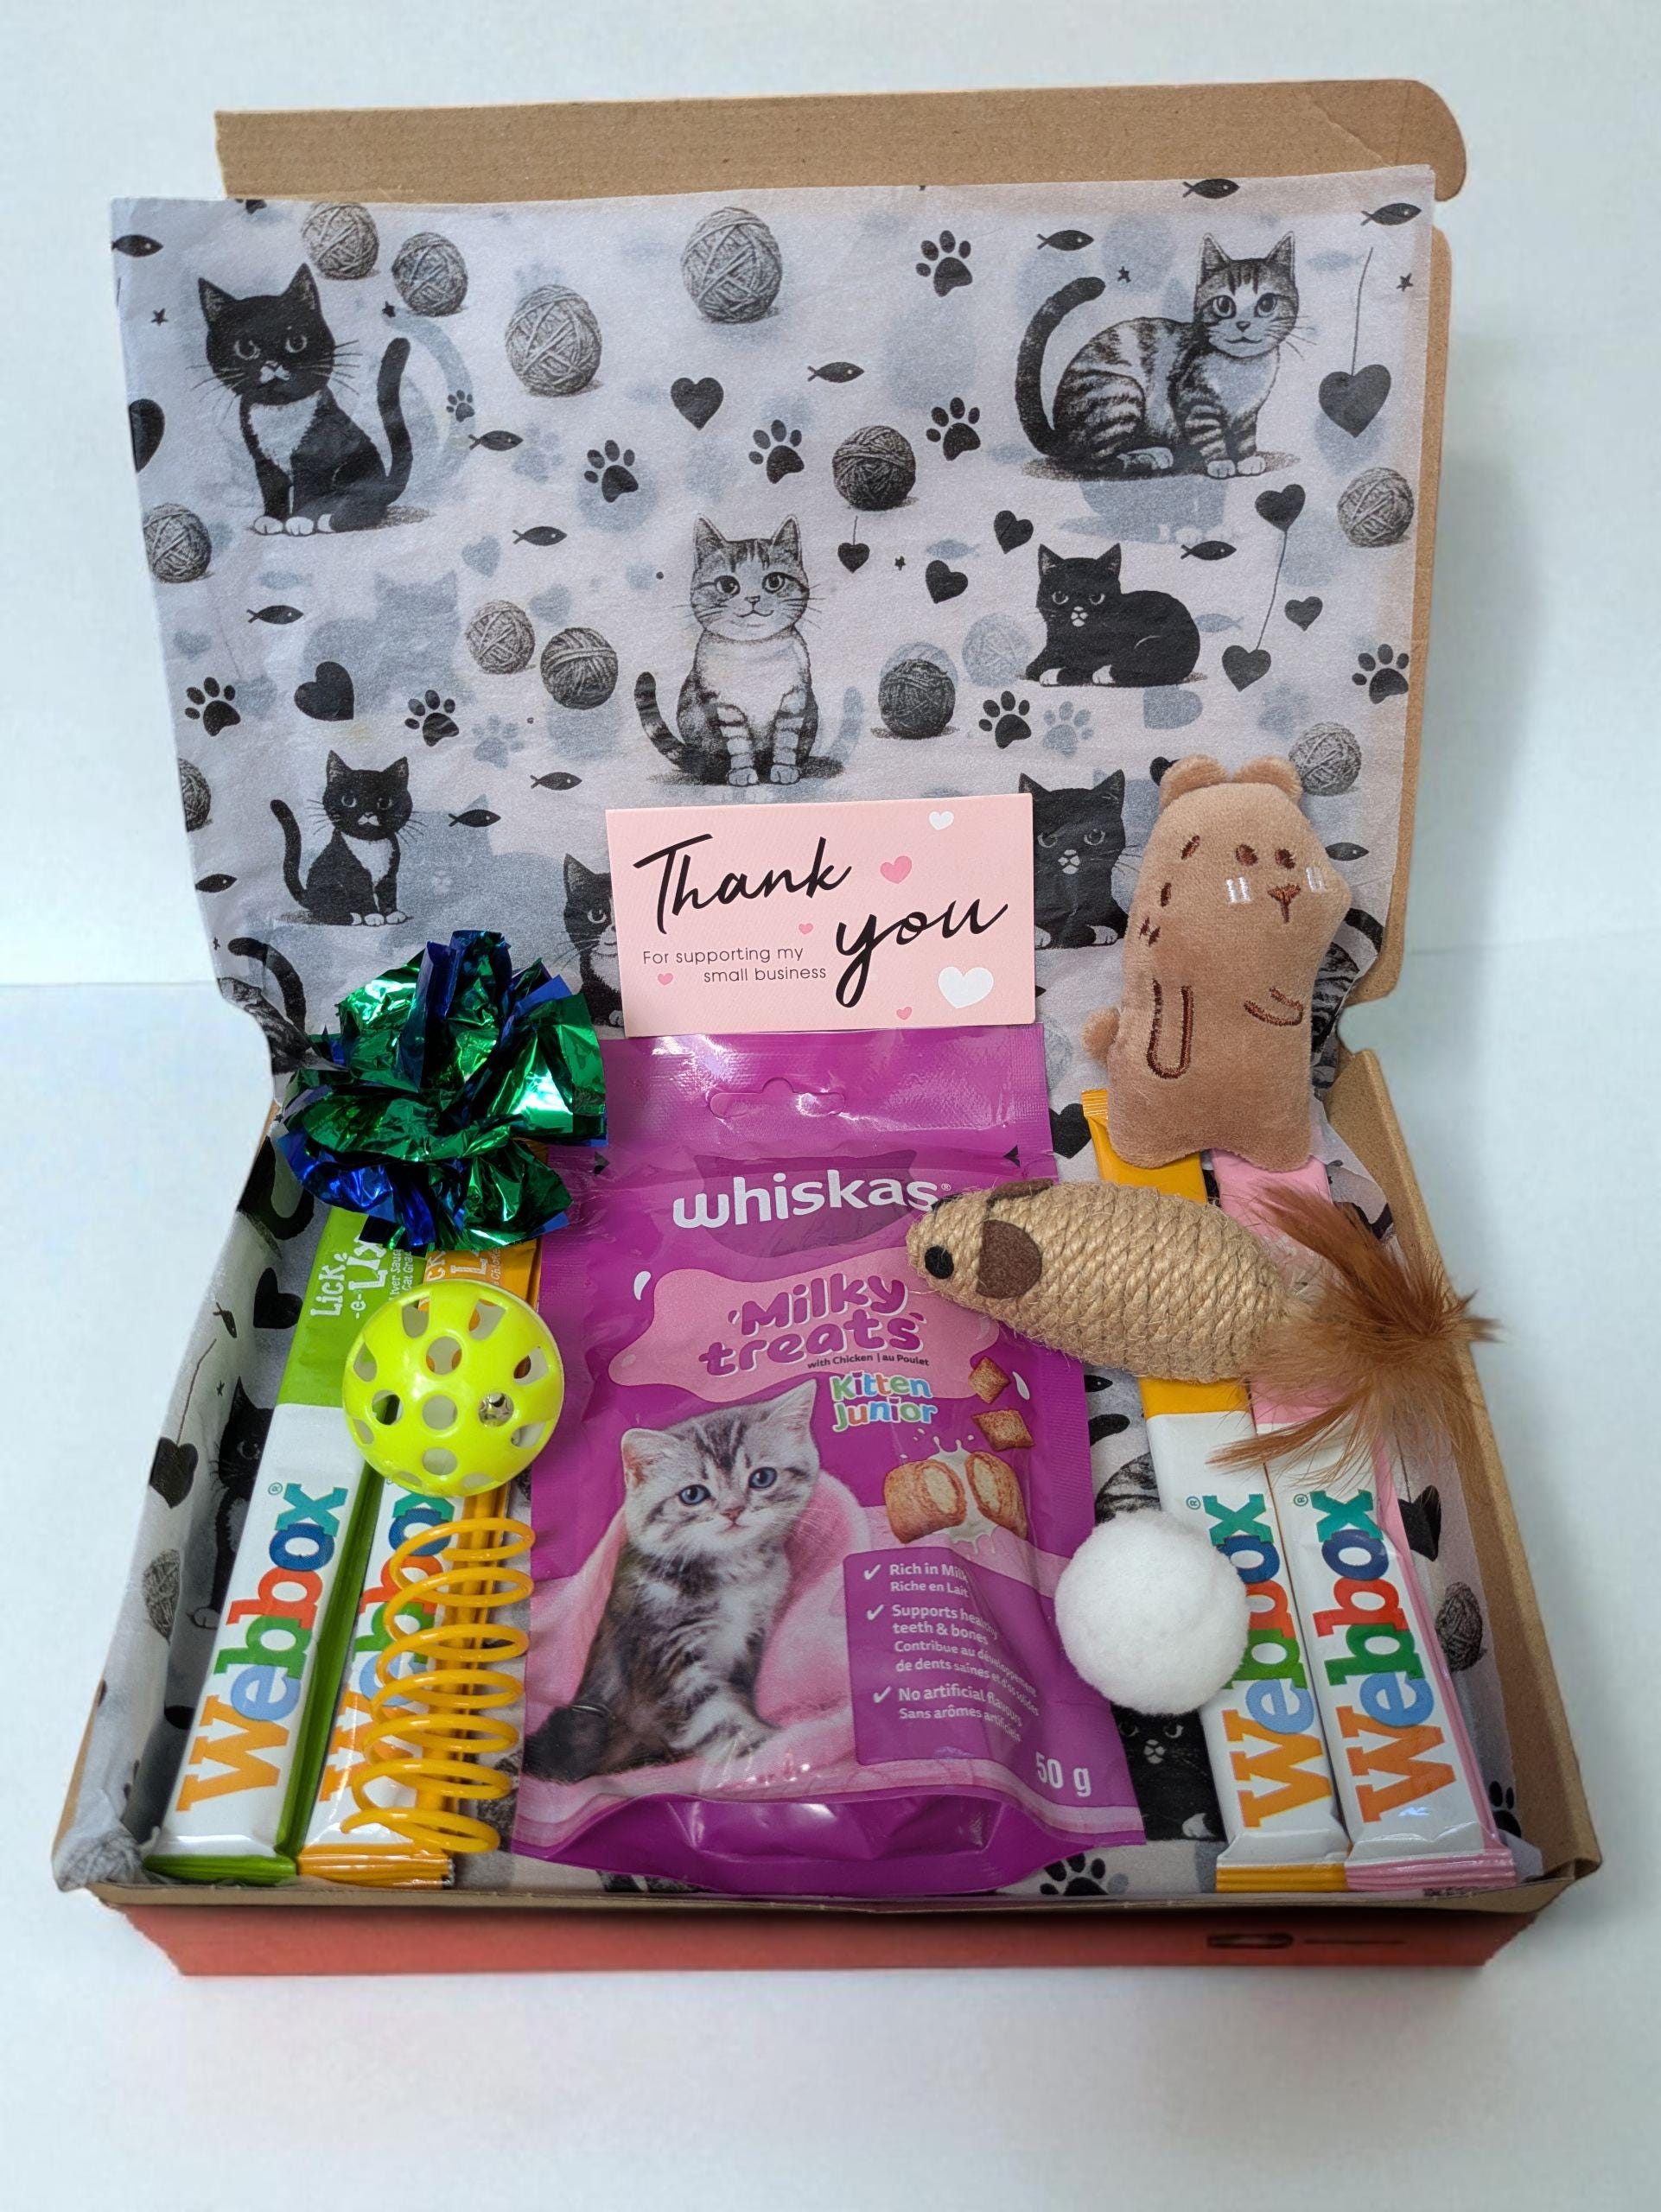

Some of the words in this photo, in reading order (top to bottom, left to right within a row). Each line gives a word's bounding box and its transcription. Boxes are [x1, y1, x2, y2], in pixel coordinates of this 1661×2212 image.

[633, 833, 852, 935] Thank
[643, 950, 670, 965] For
[676, 947, 771, 966] supporting
[777, 946, 805, 963] my
[835, 899, 1009, 1008] you
[703, 968, 748, 983] small
[754, 965, 826, 982] business
[741, 1273, 909, 1338] Milky
[698, 1309, 924, 1376] treats
[807, 1357, 830, 1369] with
[832, 1354, 873, 1364] Chicken
[897, 1354, 930, 1366] Poulet
[830, 1370, 933, 1402] Kitten
[832, 1396, 938, 1433] Junior
[889, 1564, 922, 1576] Rich
[925, 1562, 939, 1575] in
[942, 1565, 969, 1583] Milk
[890, 1581, 926, 1592] Riche
[929, 1584, 945, 1592] en
[947, 1582, 970, 1598] Lait
[892, 1605, 958, 1619] Supports
[893, 1620, 933, 1634] teeth
[936, 1623, 949, 1636] &
[951, 1624, 989, 1645] bones
[175, 1482, 348, 1812] Webbox
[894, 1640, 958, 1654] Contribue
[960, 1647, 975, 1656] au
[1310, 1489, 1456, 1823] Webbox
[895, 1659, 913, 1672] de
[914, 1657, 952, 1670] dents
[953, 1662, 990, 1680] saines
[899, 1688, 920, 1700] No
[923, 1683, 986, 1702] artificial
[987, 1691, 1023, 1727] flavours
[899, 1707, 932, 1719] Sans
[933, 1703, 983, 1719] arômes
[1035, 1751, 1065, 1789] 50
[1072, 1766, 1092, 1797] g
